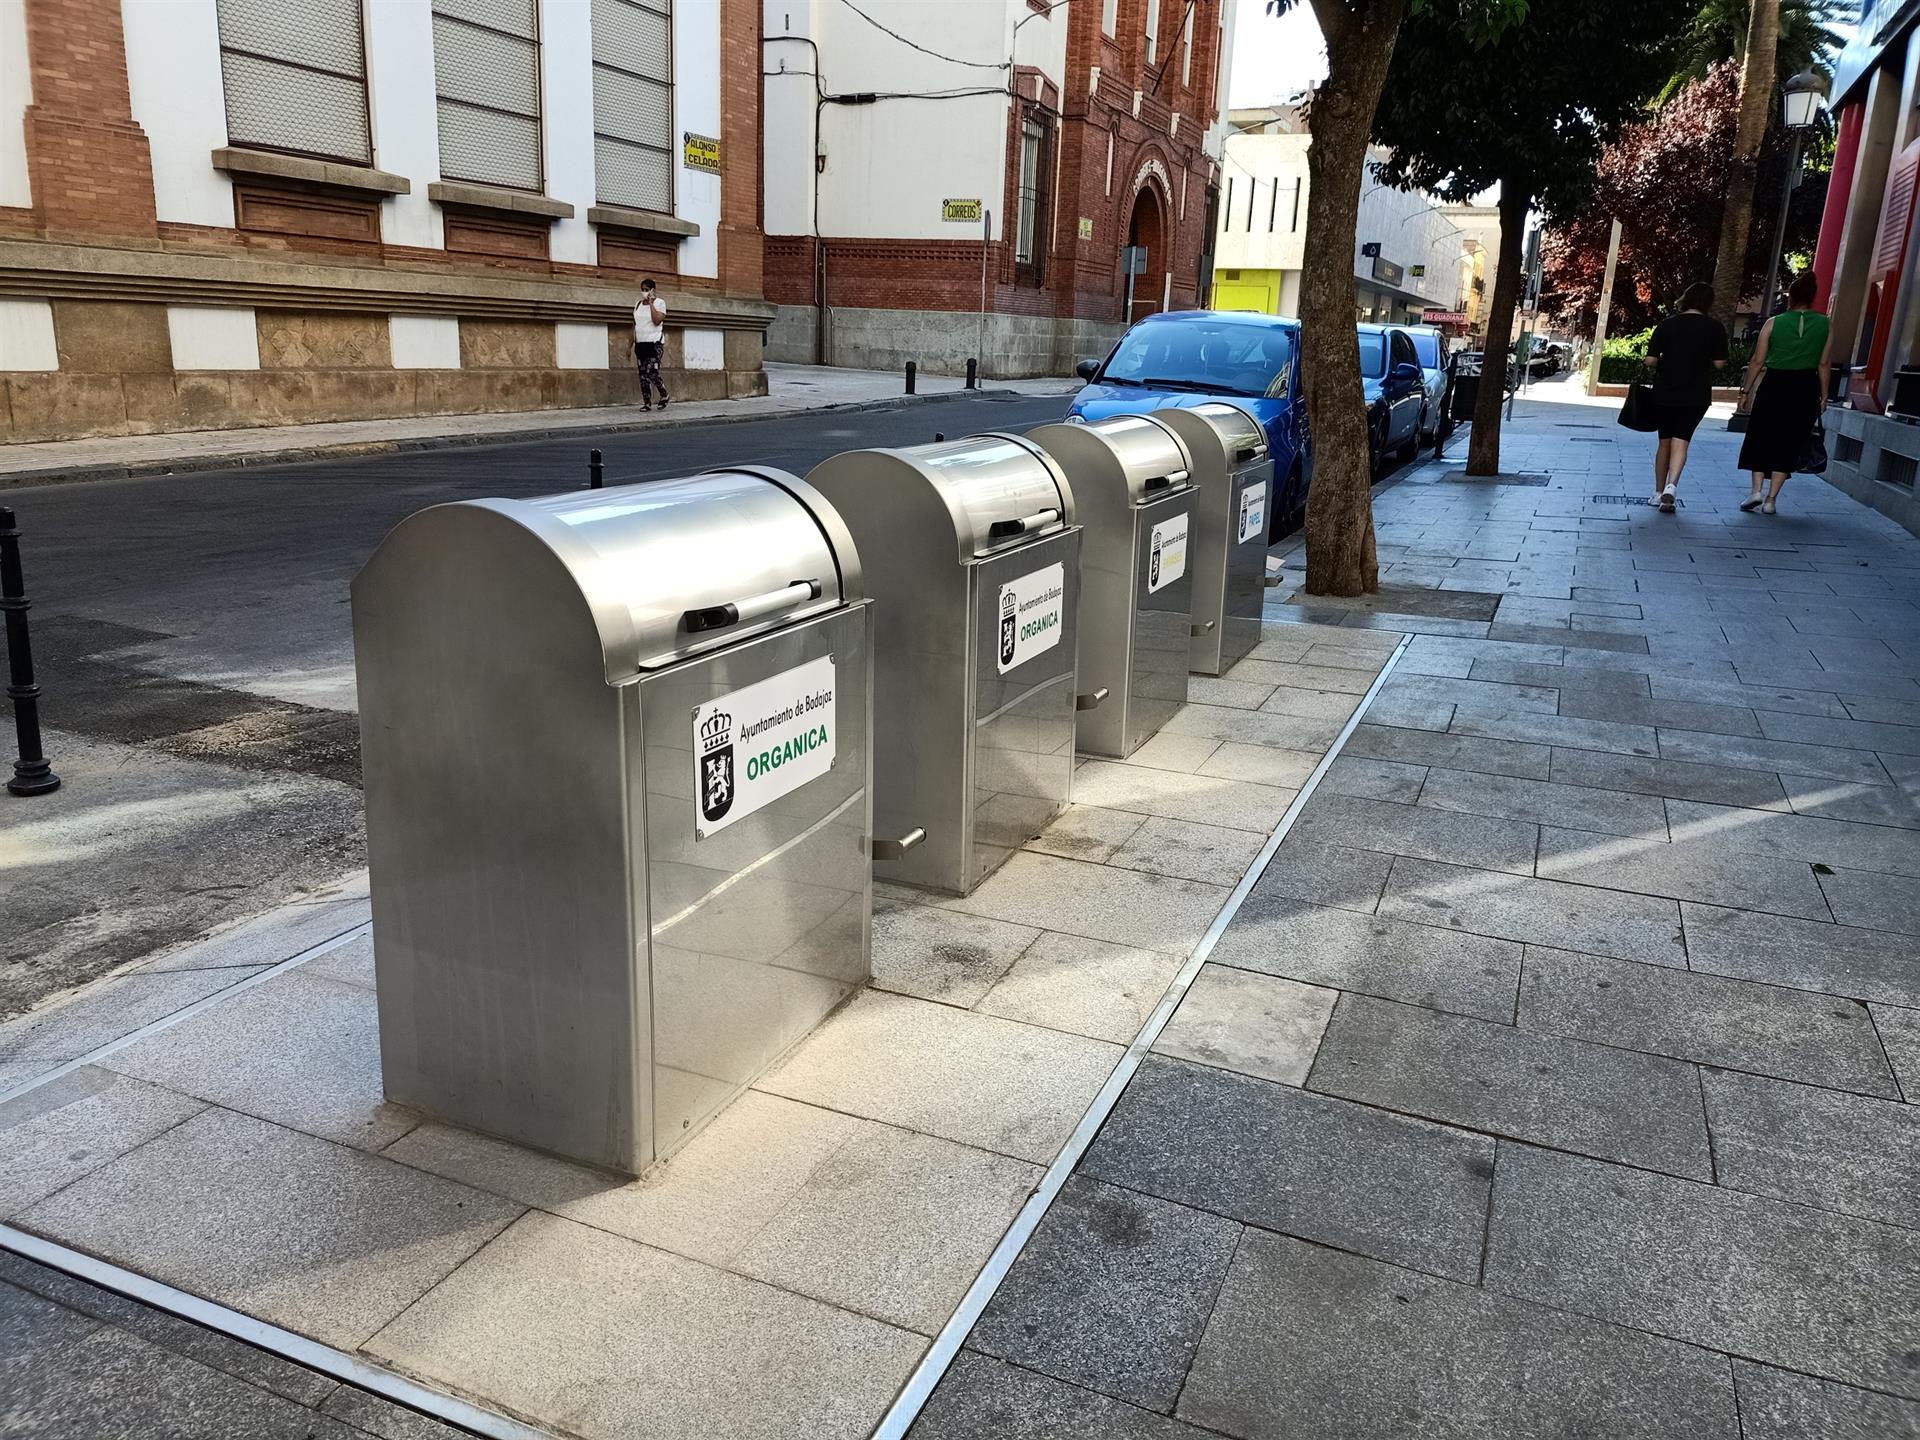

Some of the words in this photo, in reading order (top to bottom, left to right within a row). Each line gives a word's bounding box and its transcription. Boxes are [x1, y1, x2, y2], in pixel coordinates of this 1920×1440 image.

[690, 139, 716, 153] ALONSO
[688, 153, 718, 168] CELADA
[947, 204, 976, 218] CORREOS
[1020, 610, 1059, 642] ORGANICA
[740, 707, 793, 743] Ayuntamiento
[794, 699, 804, 717] de
[805, 689, 832, 712] Badajoz
[747, 723, 828, 781] ORGANICA
